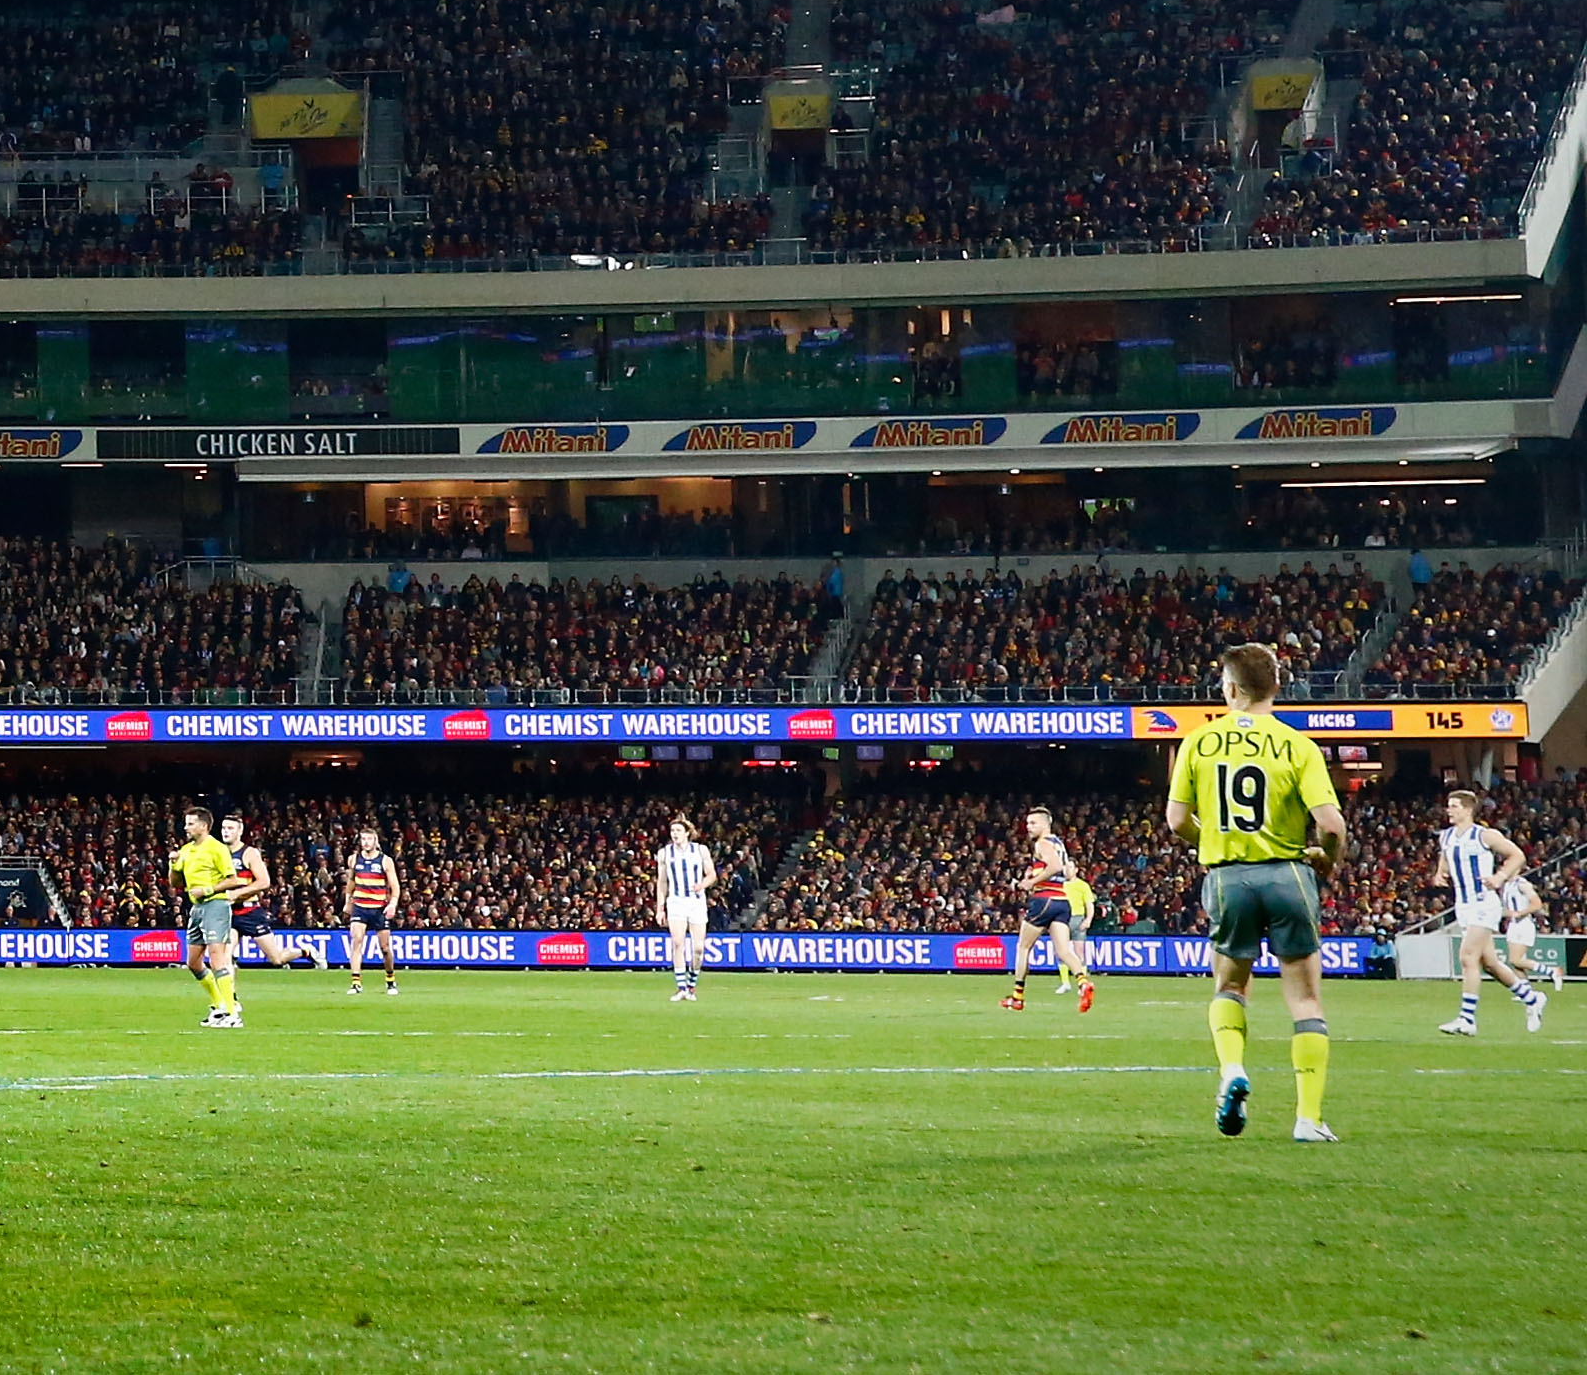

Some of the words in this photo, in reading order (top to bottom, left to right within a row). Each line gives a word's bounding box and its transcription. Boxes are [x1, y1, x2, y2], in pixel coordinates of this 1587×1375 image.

[685, 425, 793, 452] Mitani
[873, 421, 983, 447] Mitani
[1064, 416, 1176, 443] Mitani
[1259, 411, 1372, 440] Mitani
[196, 433, 296, 457] CHICKEN
[304, 433, 358, 456] SALT
[498, 427, 607, 453] Mitani
[167, 716, 272, 735] CHEMIST
[282, 715, 425, 735] WAREHOUSE
[506, 715, 613, 735] CHEMIST
[622, 714, 770, 734] WAREHOUSE
[852, 713, 961, 734] CHEMIST
[971, 713, 1123, 733] WAREHOUSE
[1309, 714, 1355, 727] KICKS
[1426, 712, 1464, 730] 145
[1197, 731, 1291, 762] OPSM
[1218, 764, 1266, 833] 19
[539, 942, 585, 954] CHEMIST
[607, 935, 741, 962] CHEST
[753, 938, 930, 963] WAREHOUSE
[956, 946, 1004, 958] CHEMIST
[1029, 937, 1162, 964] CMIST
